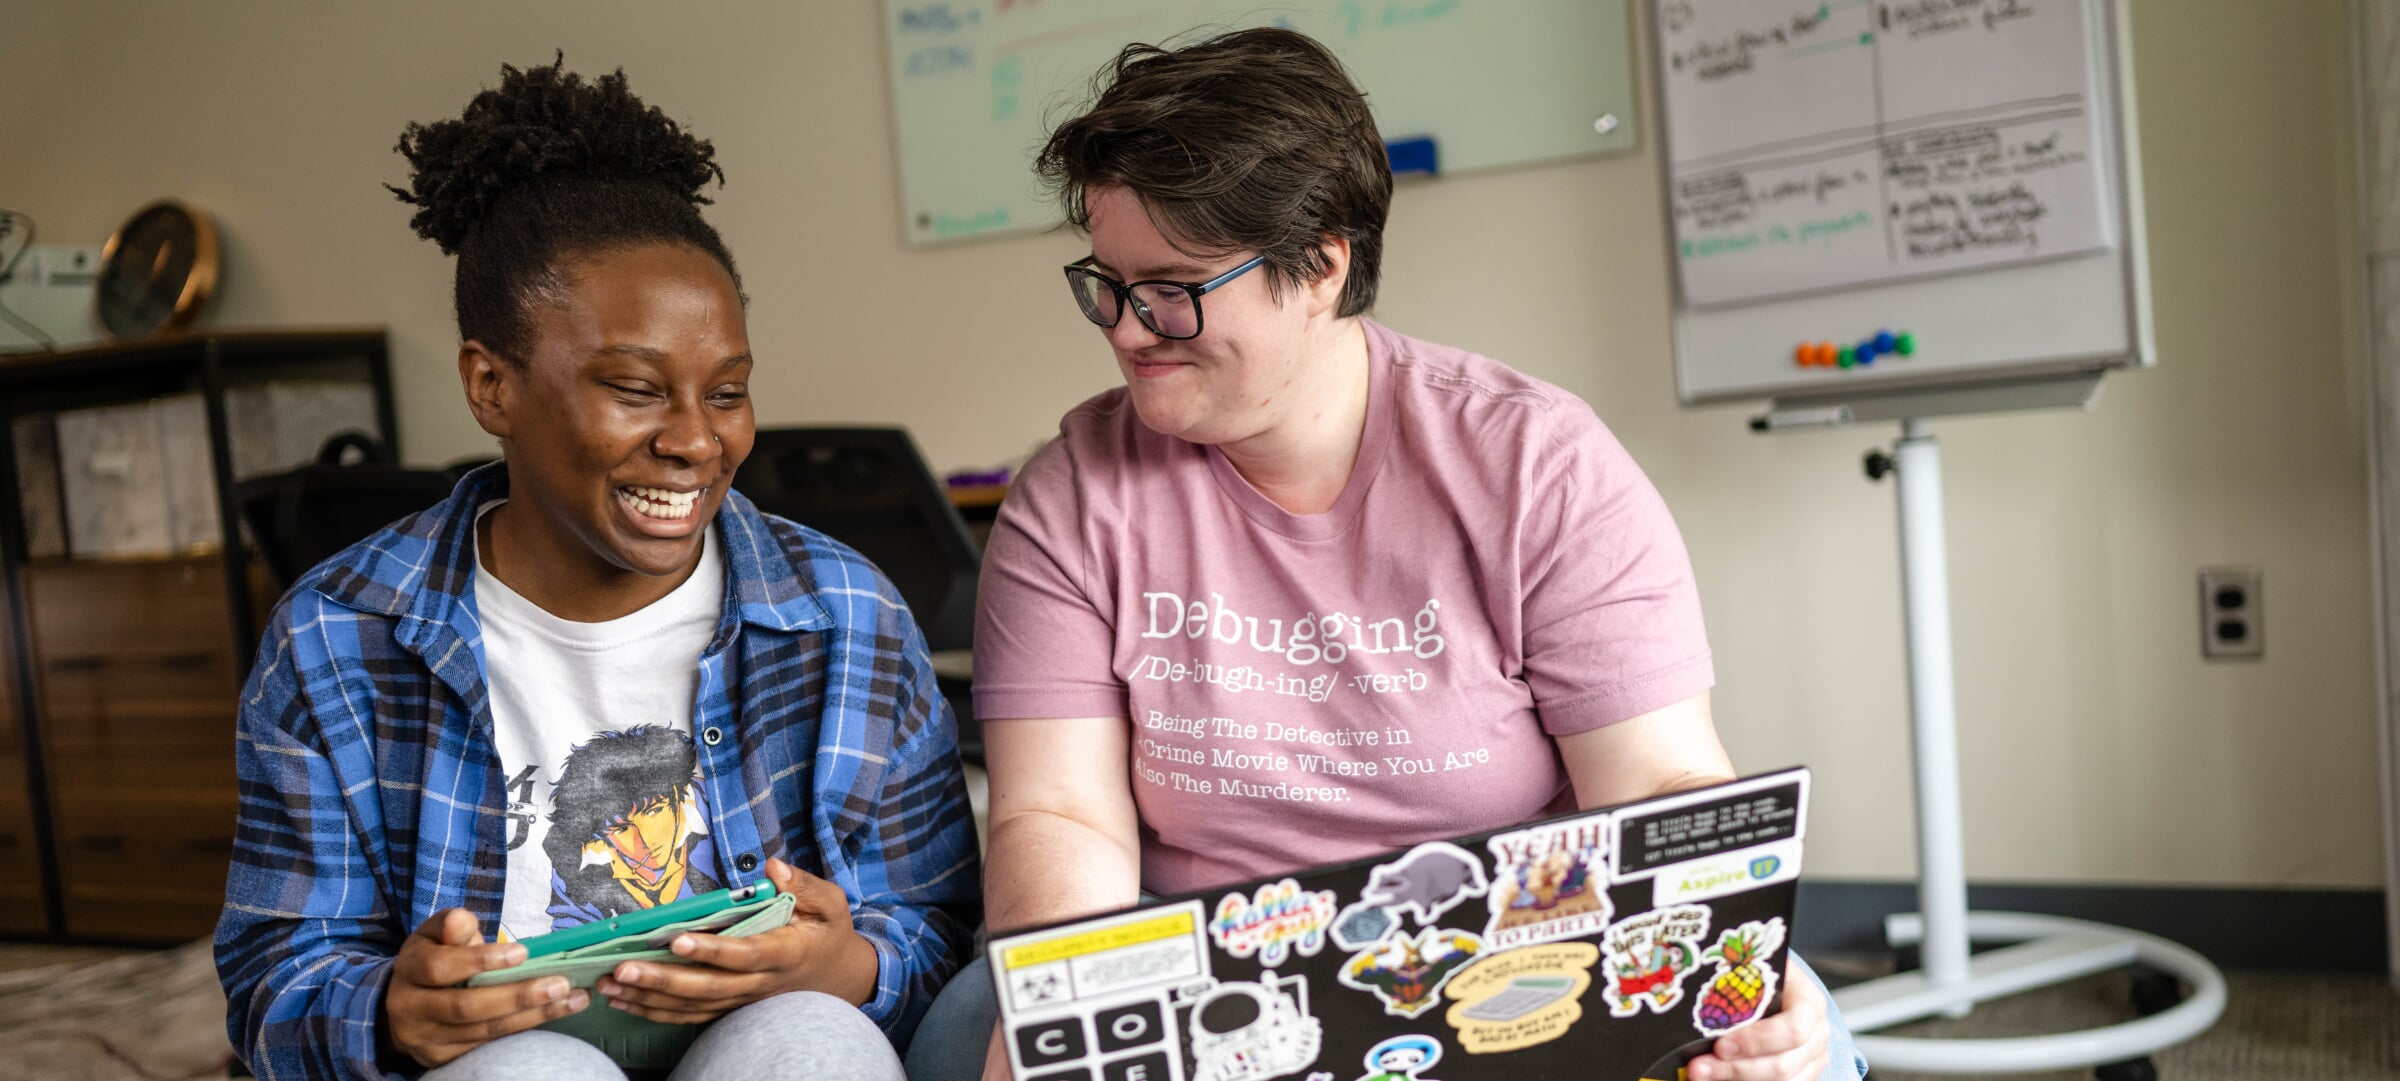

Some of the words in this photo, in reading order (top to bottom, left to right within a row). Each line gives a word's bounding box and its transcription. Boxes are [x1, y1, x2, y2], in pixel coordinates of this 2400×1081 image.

[1141, 592, 1445, 665] Debugging
[1129, 655, 1339, 702] /De-bugh-ing/
[1347, 669, 1428, 695] -verb
[1145, 710, 1207, 739] Being
[1211, 717, 1258, 740] The
[1264, 722, 1379, 747] Detective
[1386, 726, 1412, 746] in
[1143, 739, 1205, 765] Crime
[1211, 748, 1289, 772] Movie
[1297, 753, 1378, 777] Where
[1383, 756, 1434, 776] You
[1443, 747, 1490, 772] Are
[1134, 757, 1166, 787] Also
[1170, 772, 1213, 794] The
[1219, 778, 1352, 803] Murderer.
[1678, 869, 1746, 893] Aspire
[1671, 911, 1703, 921] NEED
[1494, 929, 1522, 947] TO
[1035, 1029, 1068, 1056] C
[1111, 1013, 1148, 1040] O
